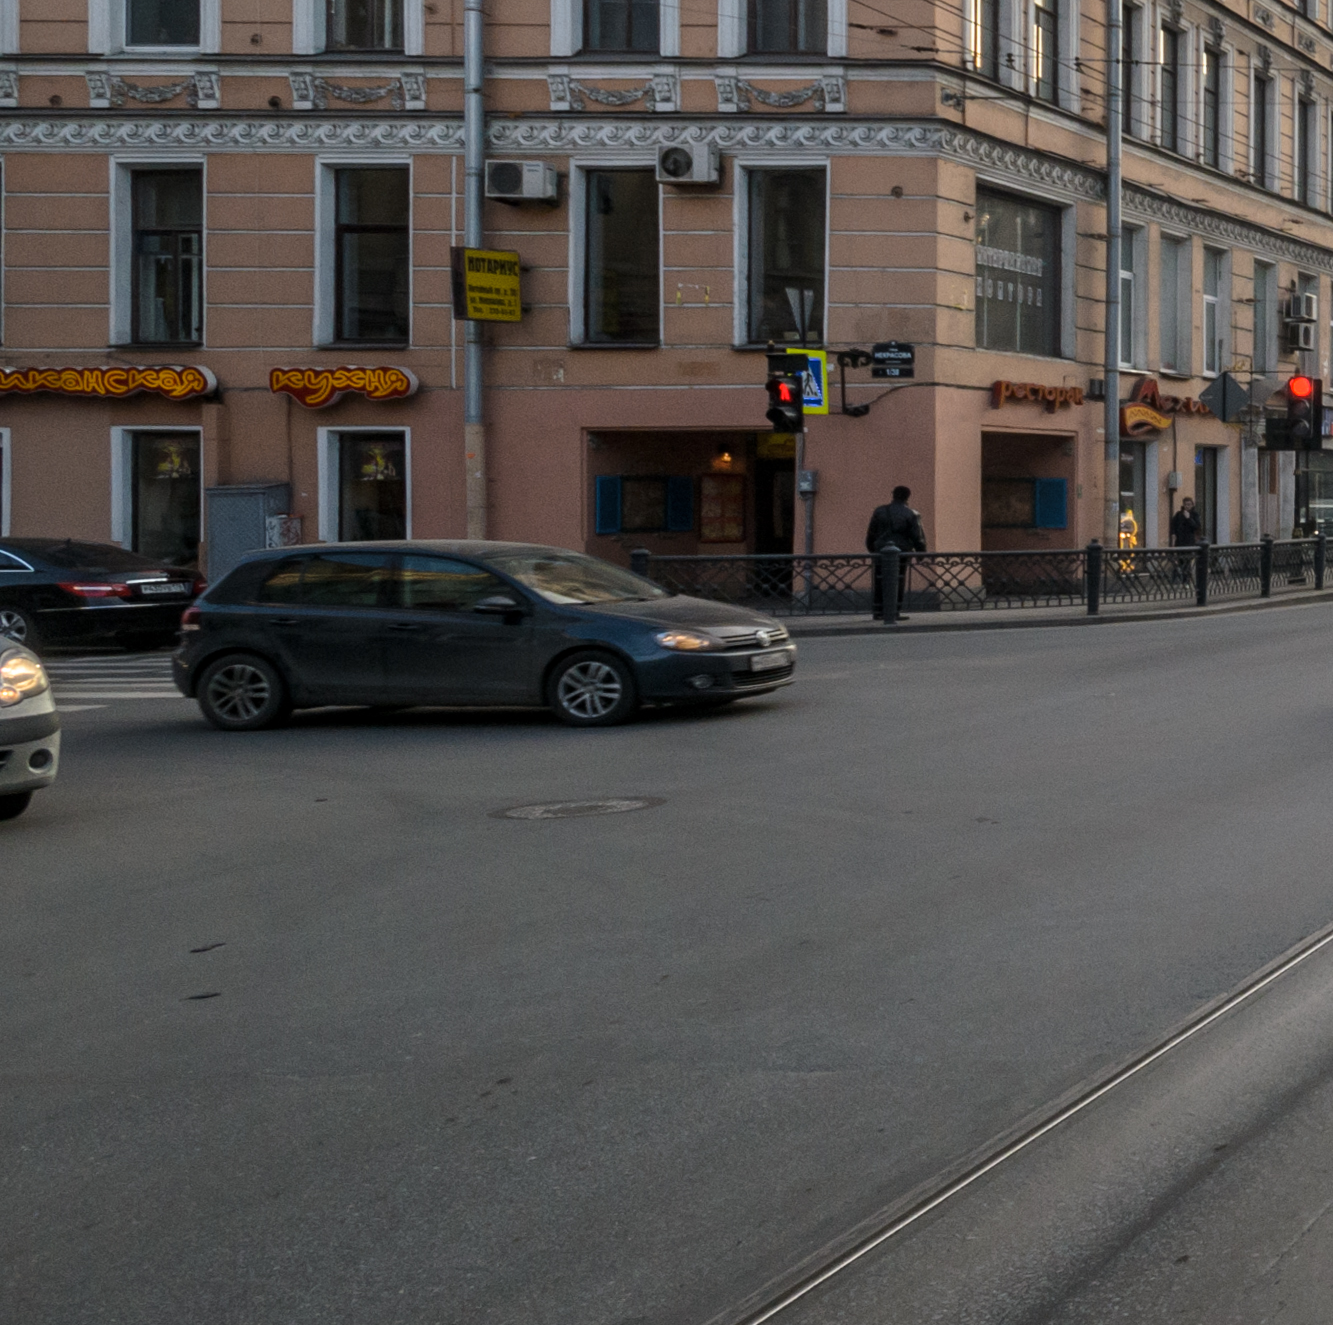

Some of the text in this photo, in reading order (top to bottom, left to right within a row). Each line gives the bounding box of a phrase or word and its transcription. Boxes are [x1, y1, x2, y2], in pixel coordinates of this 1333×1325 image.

[468, 257, 518, 276] НОТАРИУС
[874, 351, 912, 359] НЕКРАСОВА
[272, 370, 408, 404] кухня
[999, 380, 1084, 411] ресторан
